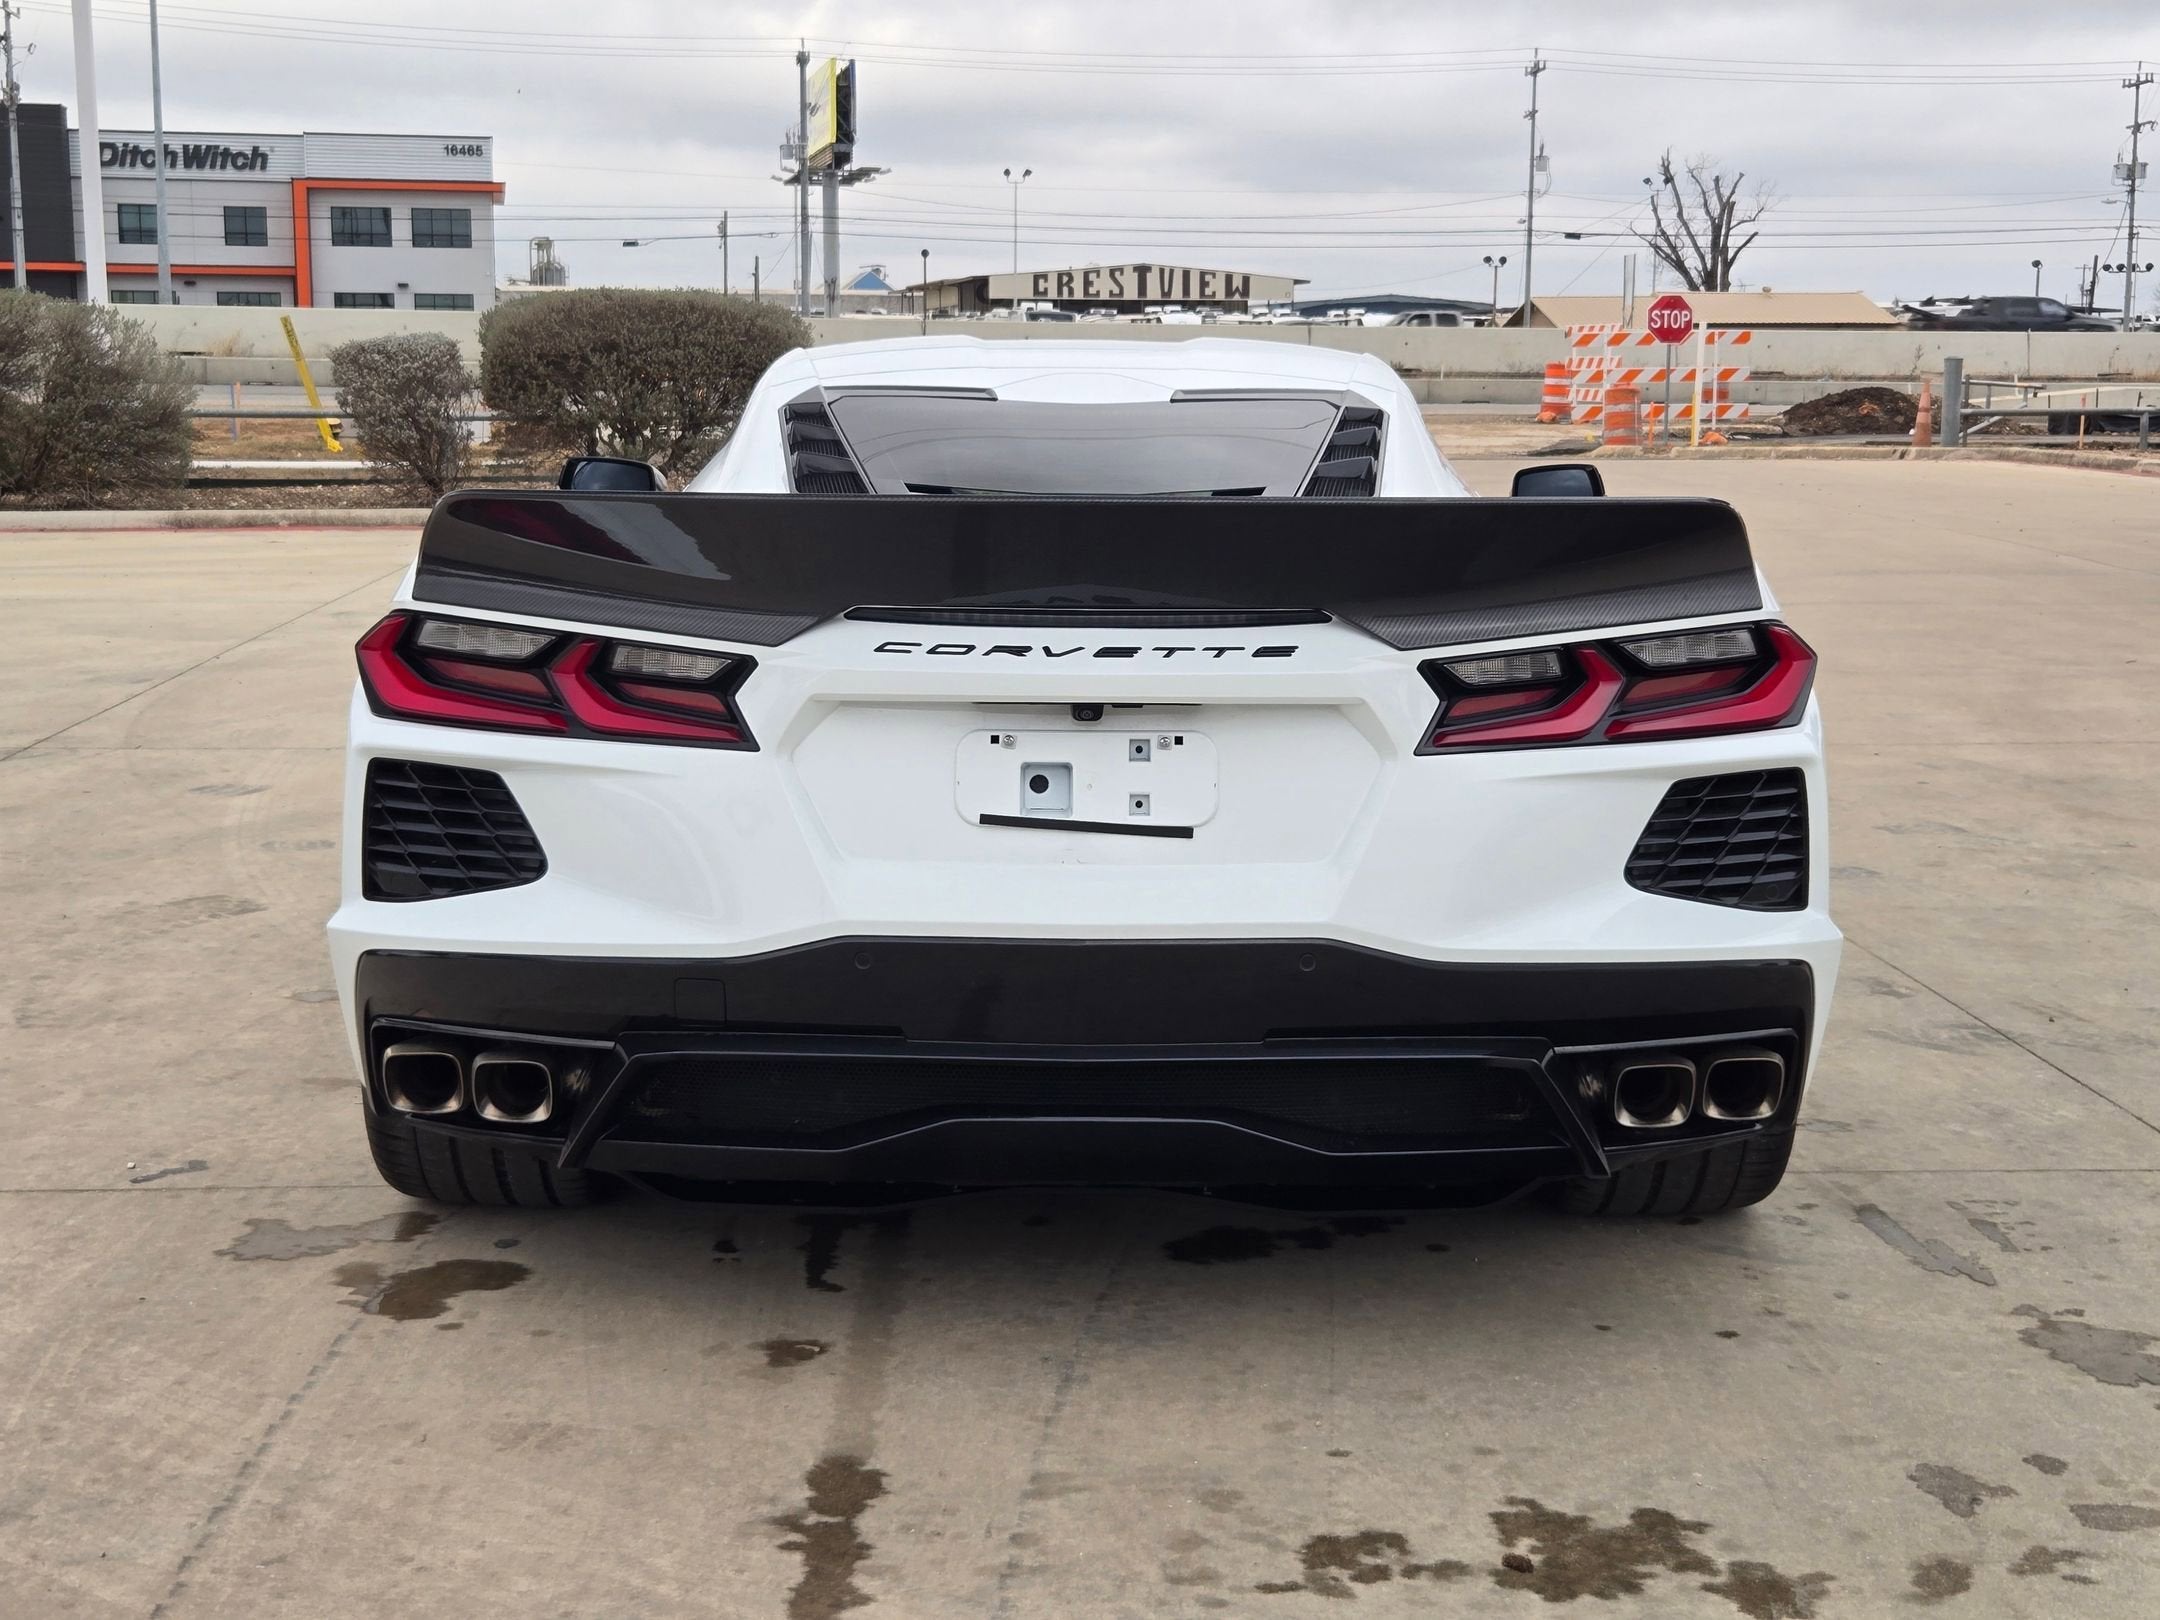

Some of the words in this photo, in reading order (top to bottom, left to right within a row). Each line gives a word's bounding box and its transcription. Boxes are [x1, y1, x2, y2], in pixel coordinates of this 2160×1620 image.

[99, 141, 178, 169] Ditch
[182, 143, 269, 171] Witch
[443, 144, 484, 157] 16465
[1033, 266, 1251, 299] CRESTVIEW
[1650, 310, 1691, 329] STOP
[873, 641, 1300, 659] CORVETTE
